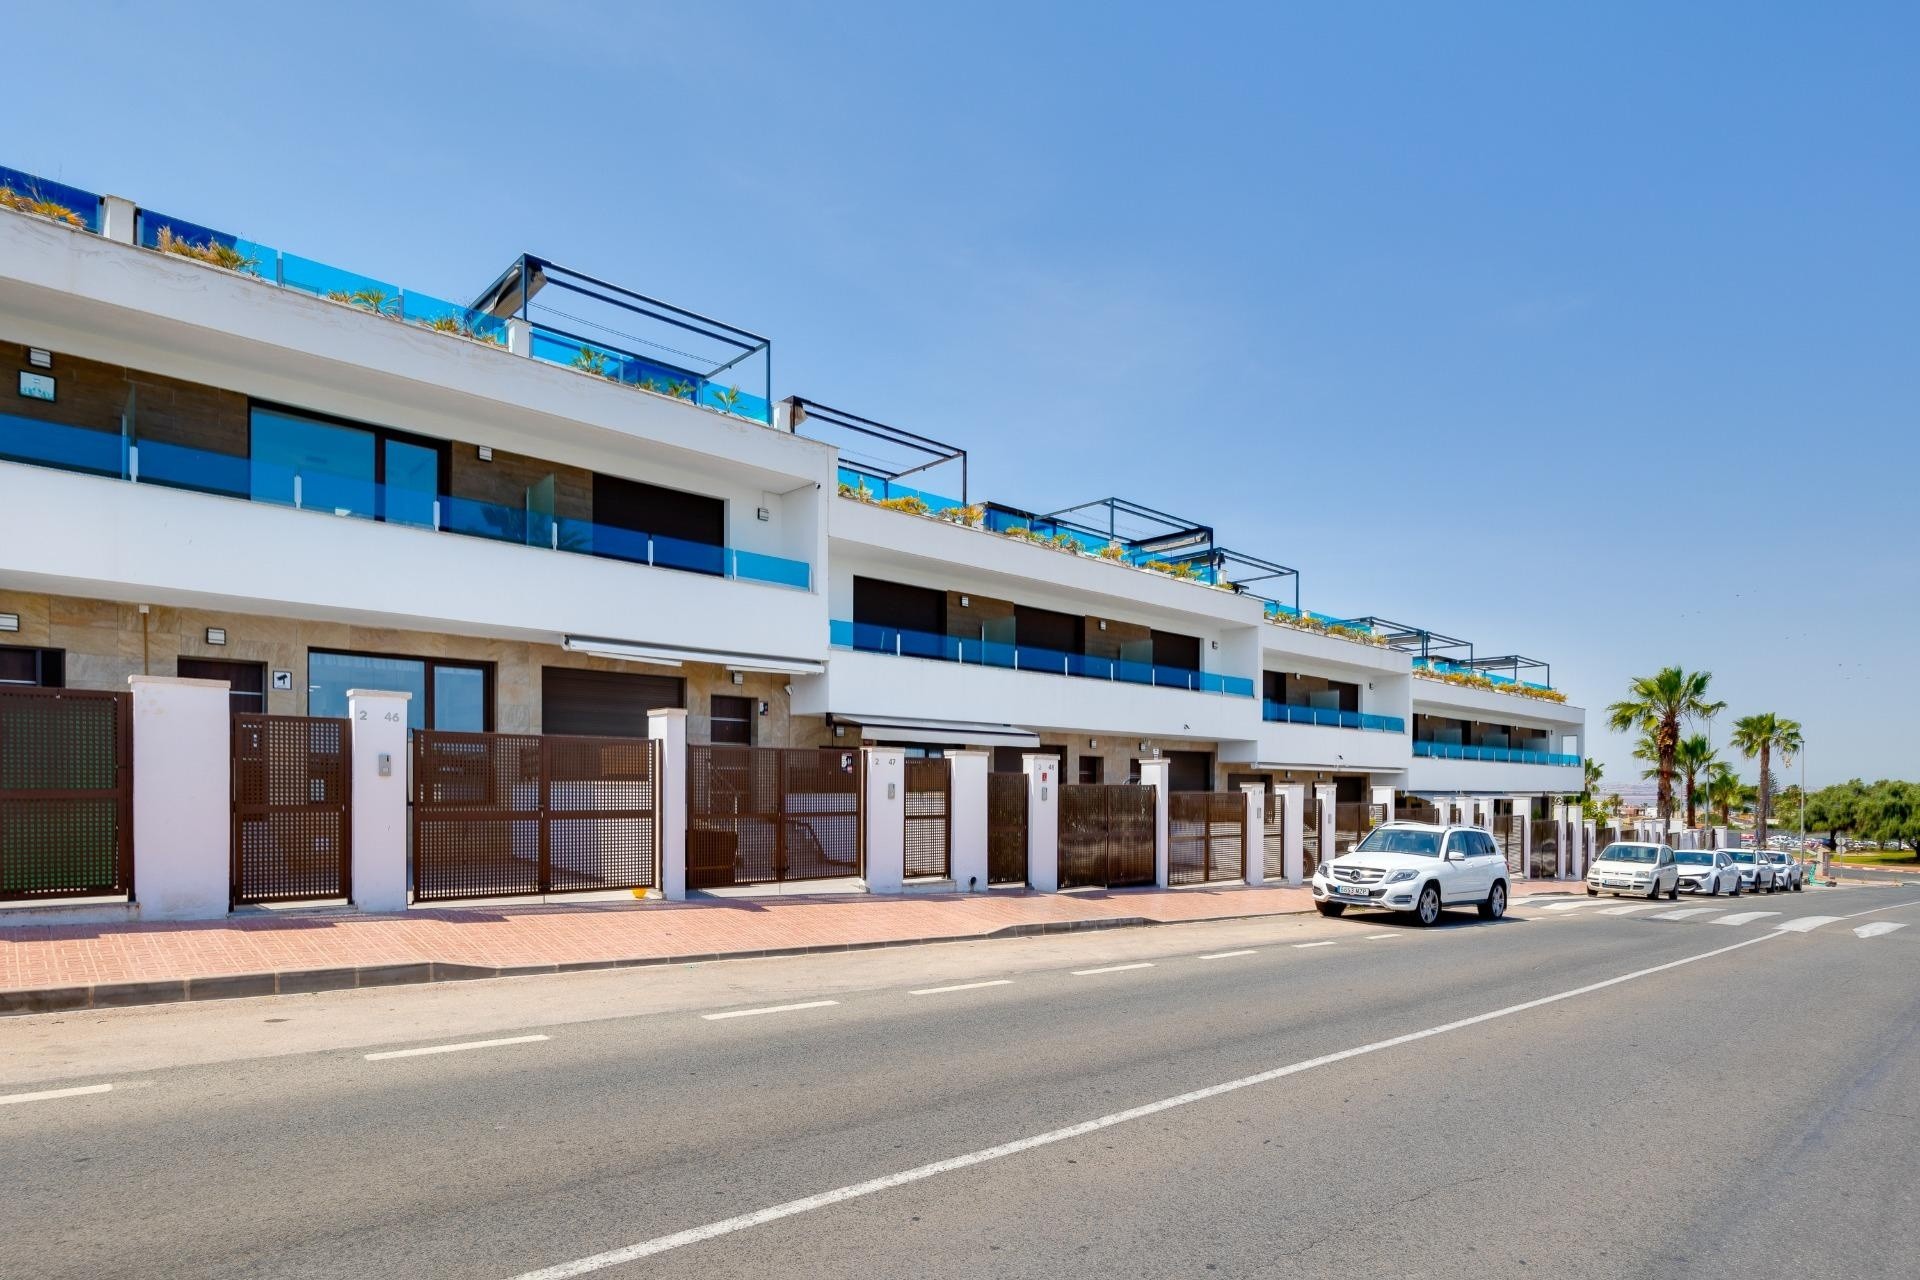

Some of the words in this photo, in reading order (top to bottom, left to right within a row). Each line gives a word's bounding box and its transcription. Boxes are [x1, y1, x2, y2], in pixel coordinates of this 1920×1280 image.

[359, 710, 368, 721] 2
[384, 711, 400, 722] 46
[874, 758, 880, 766] 2
[888, 758, 896, 766] 47
